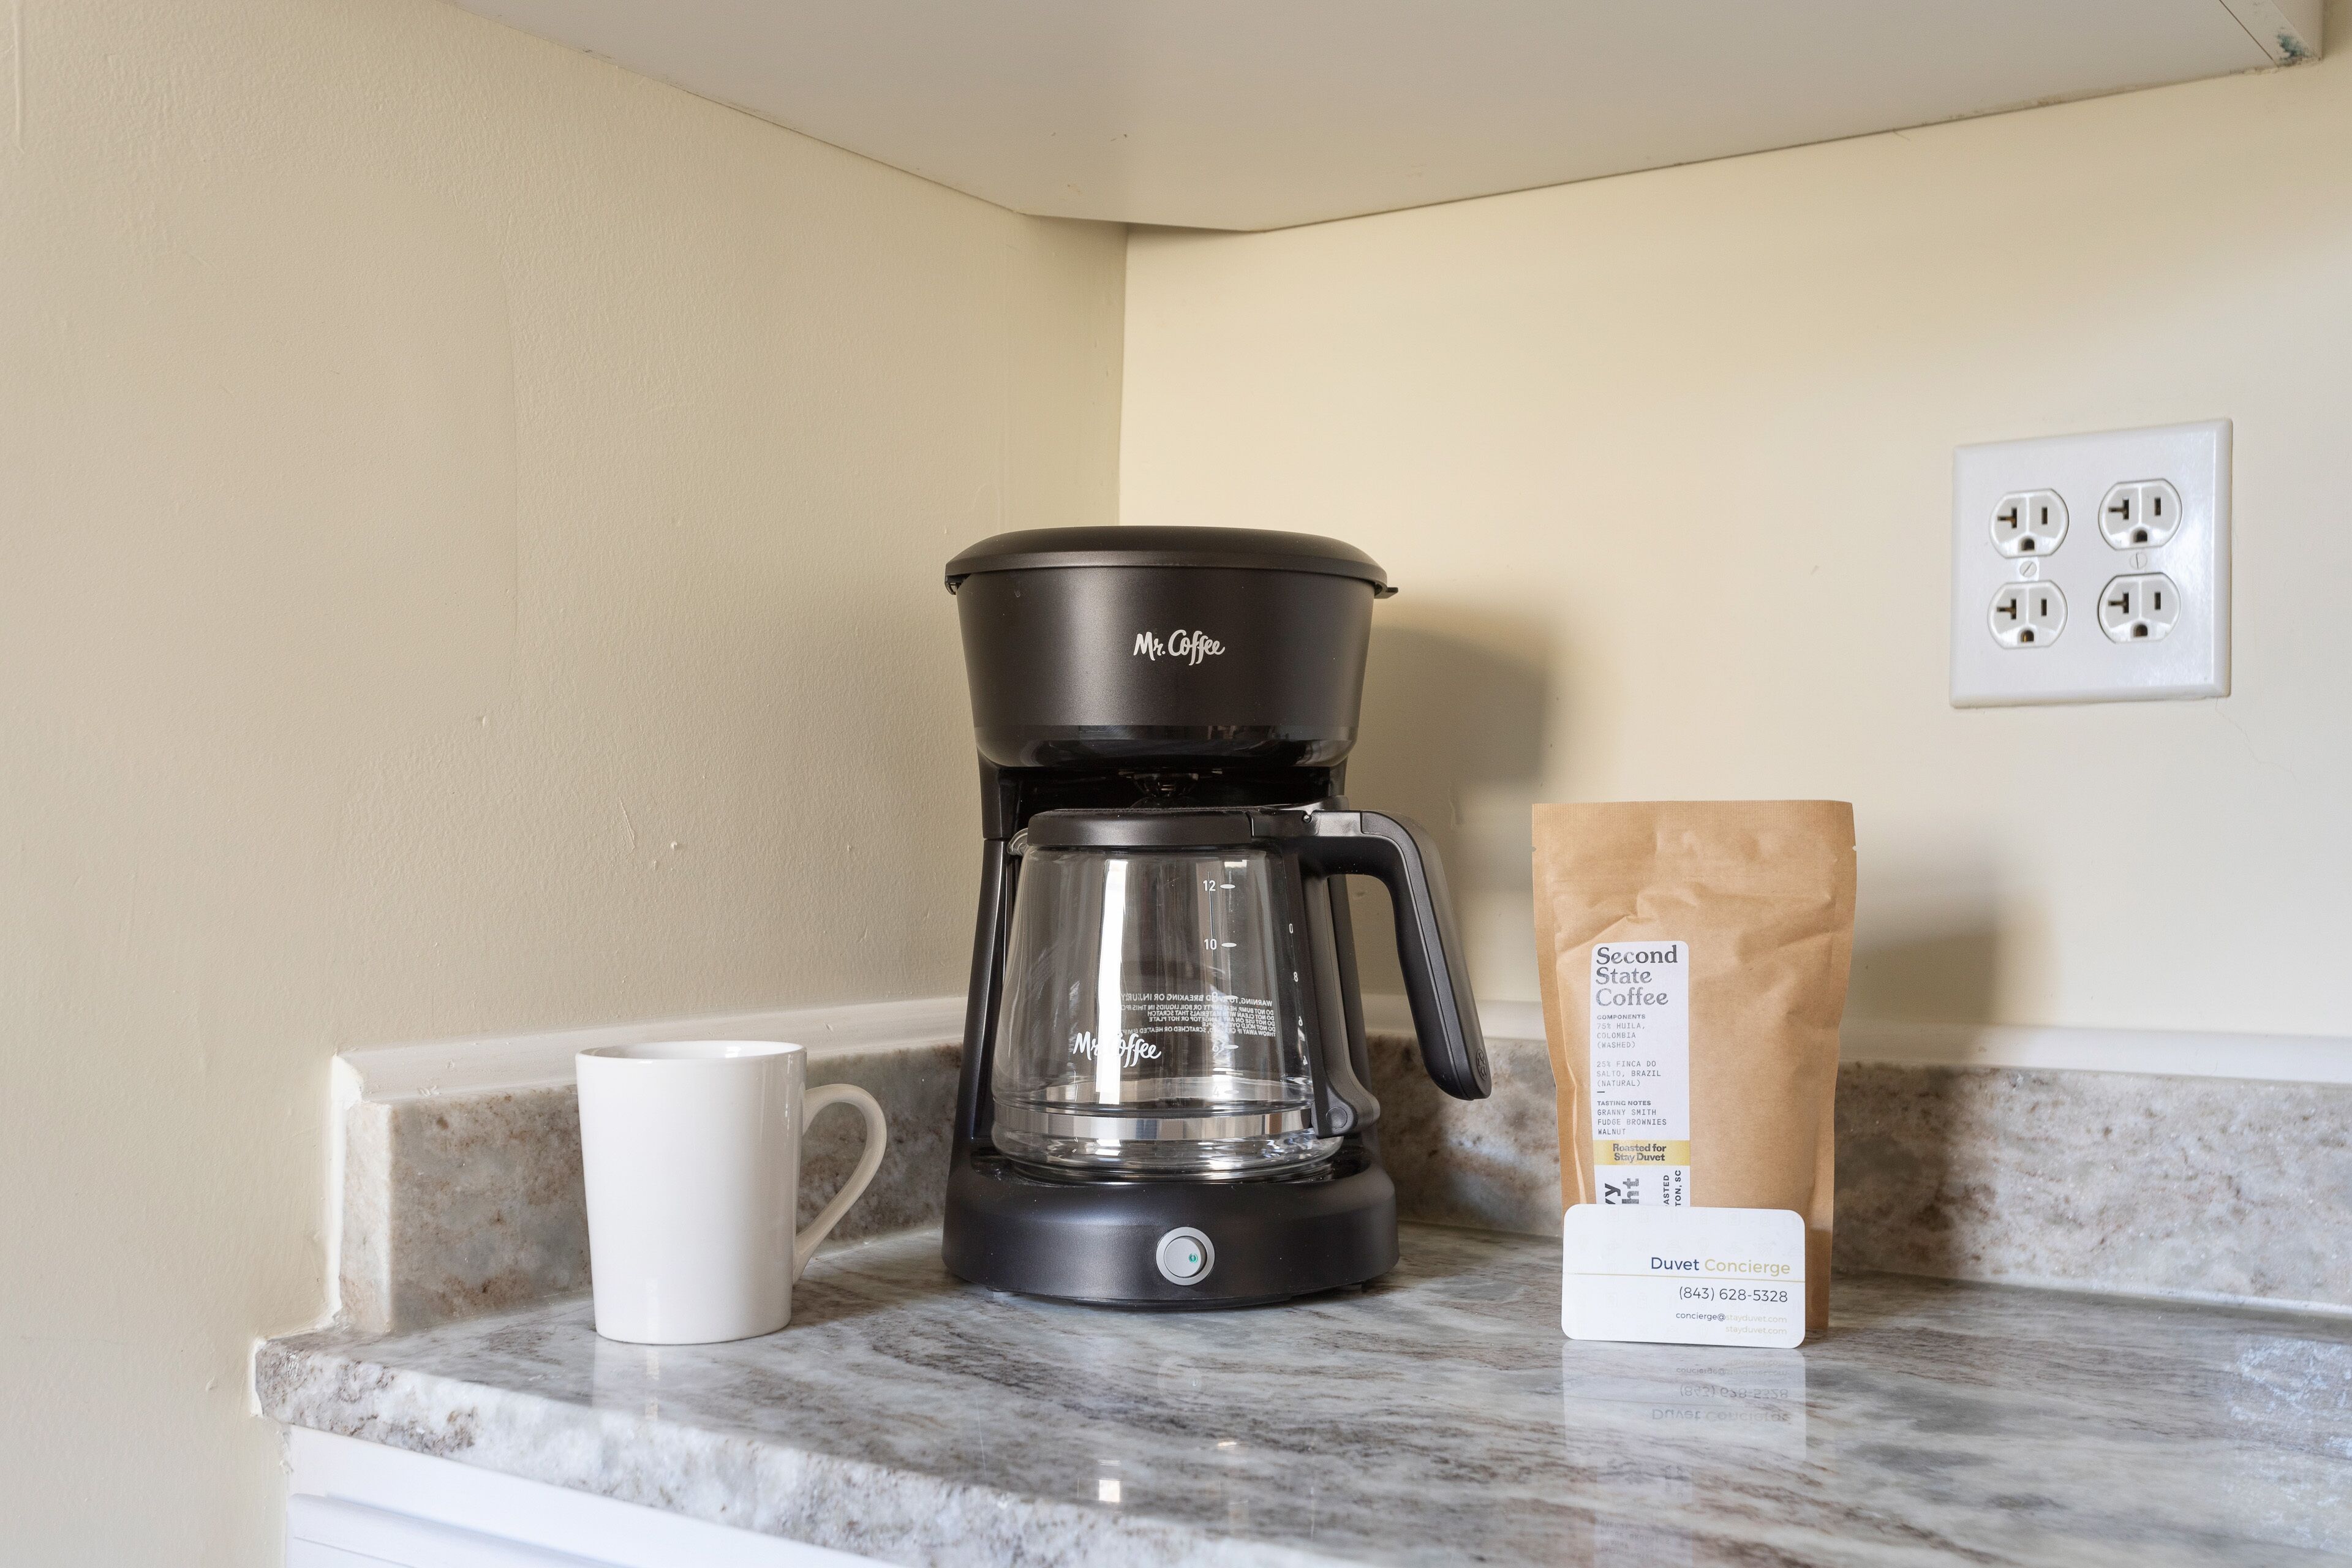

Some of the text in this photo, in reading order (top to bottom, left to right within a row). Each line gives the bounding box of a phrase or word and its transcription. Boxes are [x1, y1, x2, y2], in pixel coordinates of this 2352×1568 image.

[1133, 629, 1226, 666] Mr. Coffee
[1203, 880, 1216, 891] 12
[1204, 938, 1217, 950] 10
[1596, 944, 1678, 965] Second
[1596, 967, 1652, 984] State
[1596, 987, 1668, 1006] Coffee
[1109, 1031, 1162, 1068] offee
[1613, 1143, 1651, 1152] Roasted
[1614, 1153, 1665, 1163] Stay Duvet
[1675, 1170, 1681, 1182] SC
[1651, 1257, 1790, 1277] Duvet Concierge
[1679, 1286, 1788, 1303] (843) 628-5328
[1676, 1312, 1787, 1324] concierge@stayduvet.com
[1725, 1325, 1787, 1335] stayduvet.com
